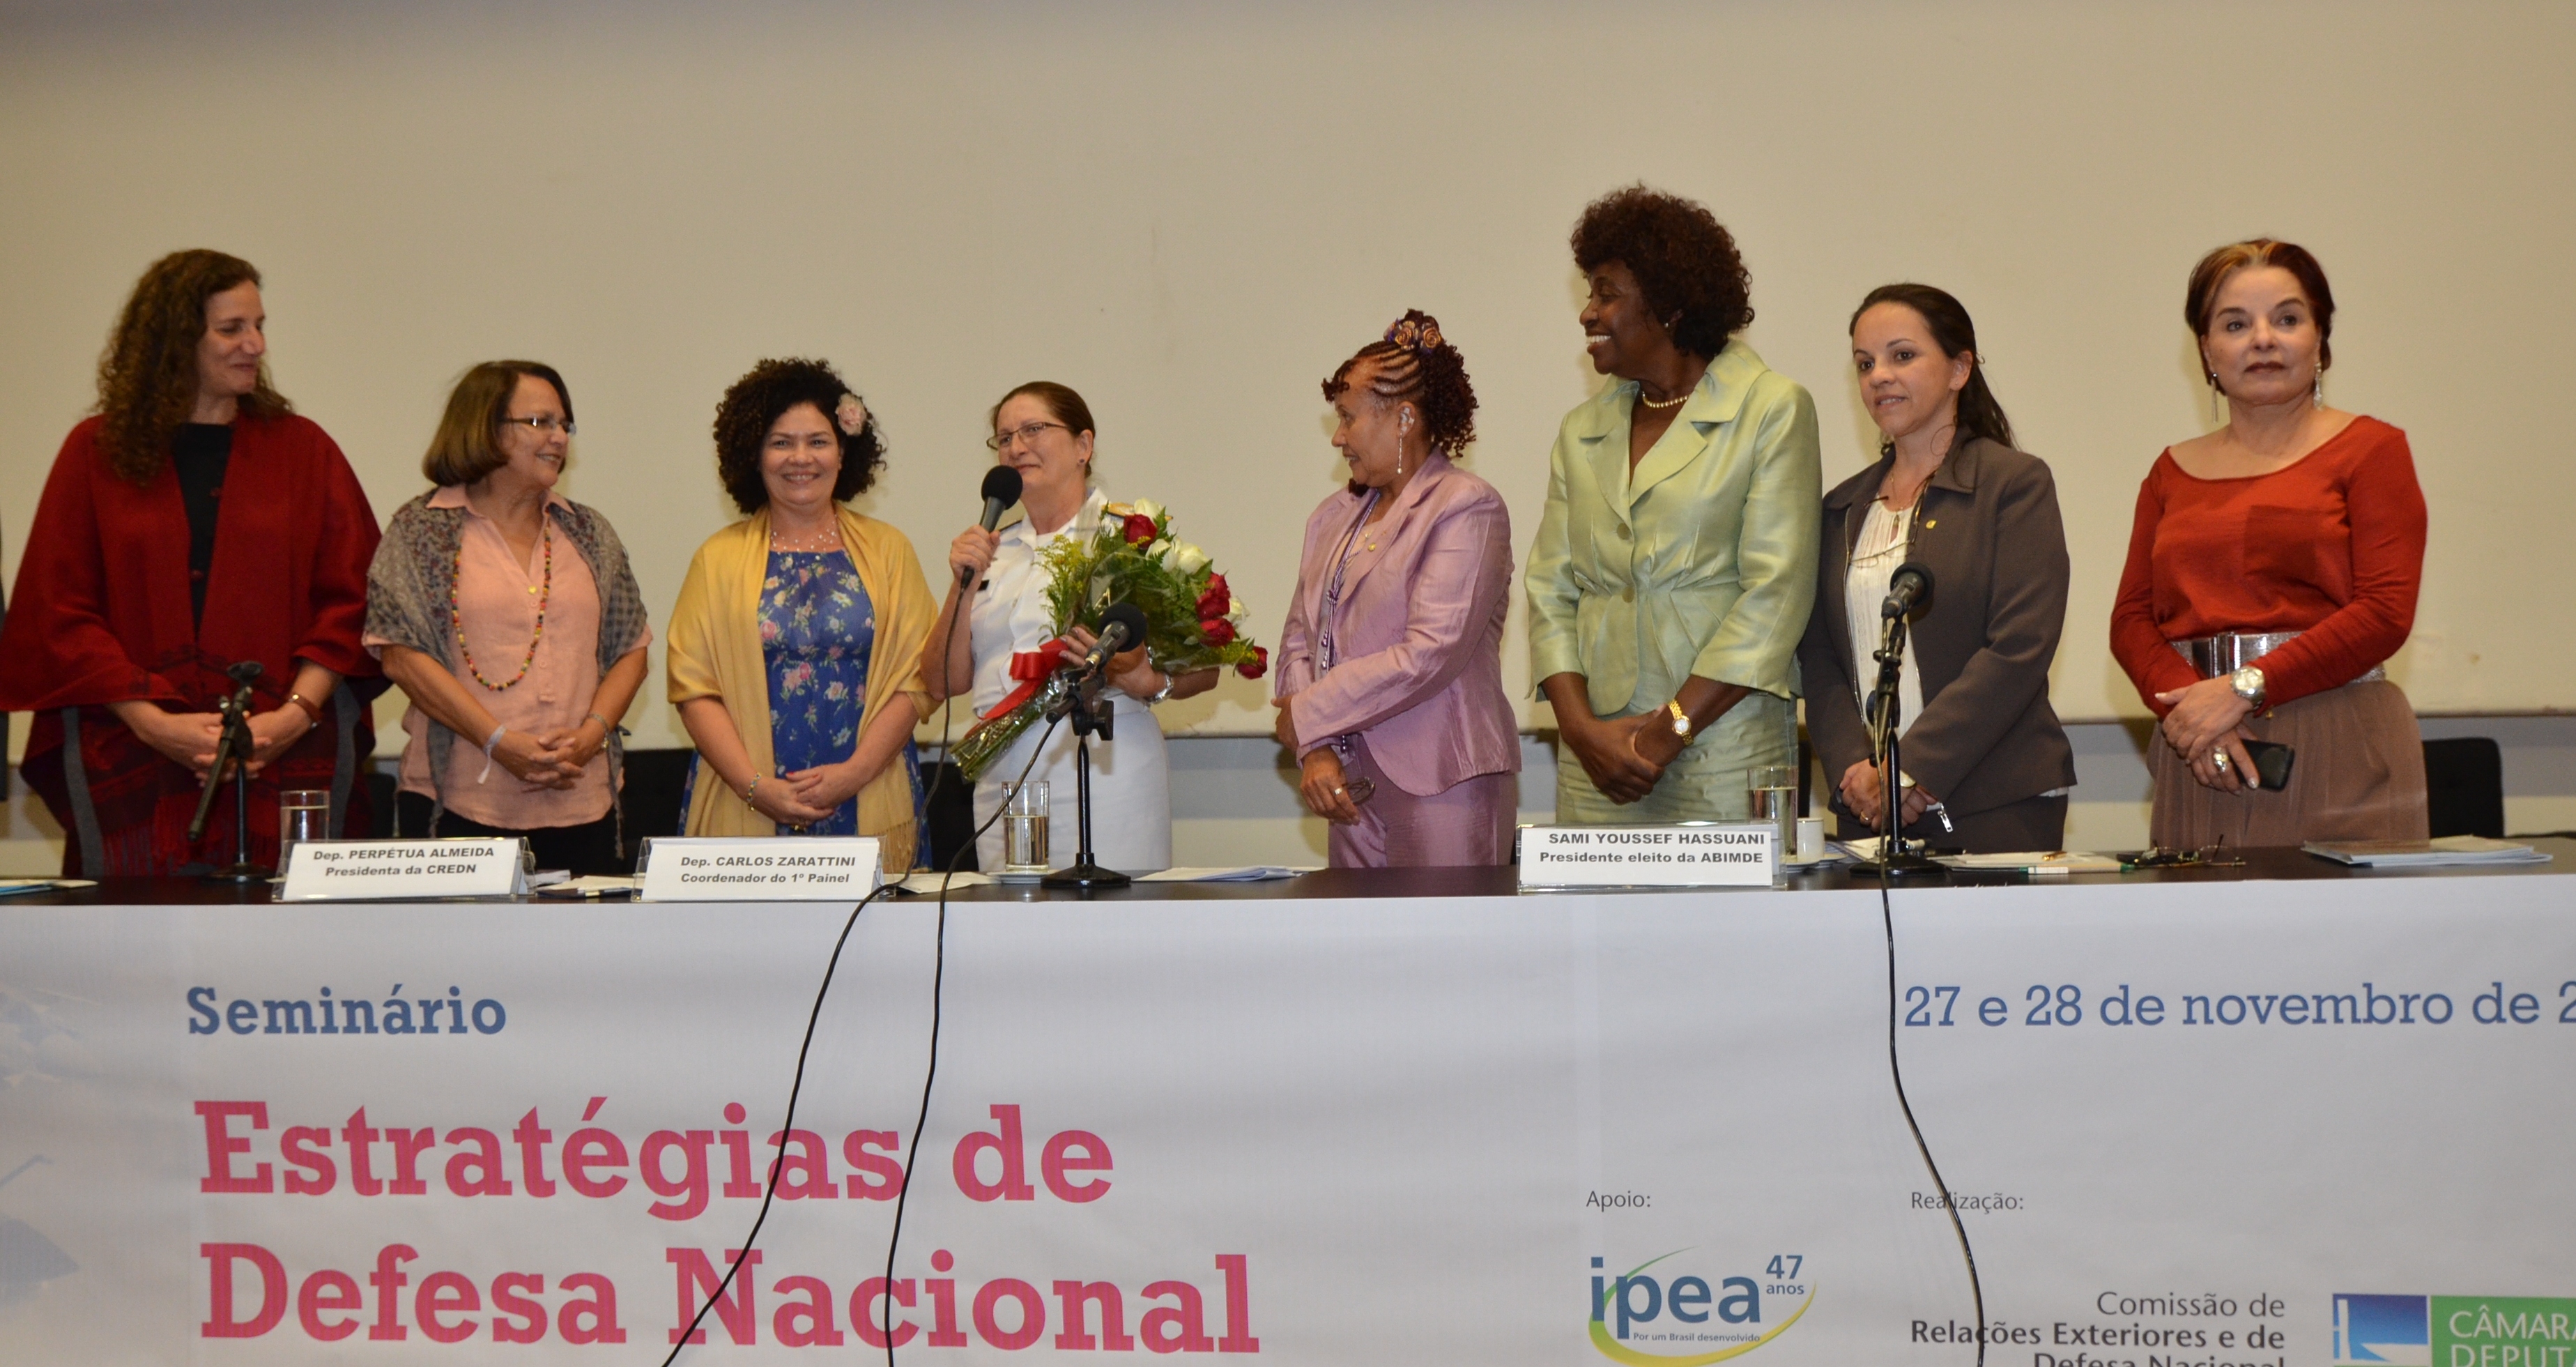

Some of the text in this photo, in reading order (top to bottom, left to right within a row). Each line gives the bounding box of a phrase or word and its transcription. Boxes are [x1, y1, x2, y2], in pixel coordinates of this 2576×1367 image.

[1548, 832, 1765, 845] SAMI YOUSSEF HASSUANI
[313, 846, 495, 862] Dep. PERPÉTUA ALMEIDA
[680, 856, 857, 869] Dep. CARLOS ZARATTINI
[1540, 851, 1763, 863] Presidente eleito da ABIMDE
[325, 864, 477, 877] Presidenta da CREDN
[680, 872, 767, 883] Coordenador
[769, 872, 787, 883] do
[808, 872, 850, 883] Painel
[189, 984, 507, 1035] Seminário
[1905, 986, 1962, 1027] 27
[1979, 997, 2009, 1027] e
[2025, 984, 2084, 1027] 28
[2101, 984, 2166, 1027] de
[2183, 983, 2455, 1025] novembro
[2472, 982, 2540, 1025] de
[194, 1097, 1114, 1222] Estratégias de
[1586, 1191, 1651, 1213] Apoio:
[1765, 1255, 1804, 1280] 47
[201, 1243, 1260, 1354] Defesa Nacional
[1590, 1257, 1761, 1340] ipea
[1765, 1283, 1805, 1295] anos
[2096, 1291, 2285, 1318] Comissão de
[2448, 1304, 2576, 1341] CÂMAR
[1633, 1332, 1649, 1341] Por
[1669, 1333, 1695, 1342] Brasil
[1697, 1333, 1761, 1343] desenvolvido
[2053, 1322, 2207, 1349] Exteriores
[2218, 1331, 2235, 1350] e
[2246, 1324, 2285, 1350] de
[2451, 1344, 2576, 1367] DEPUT
